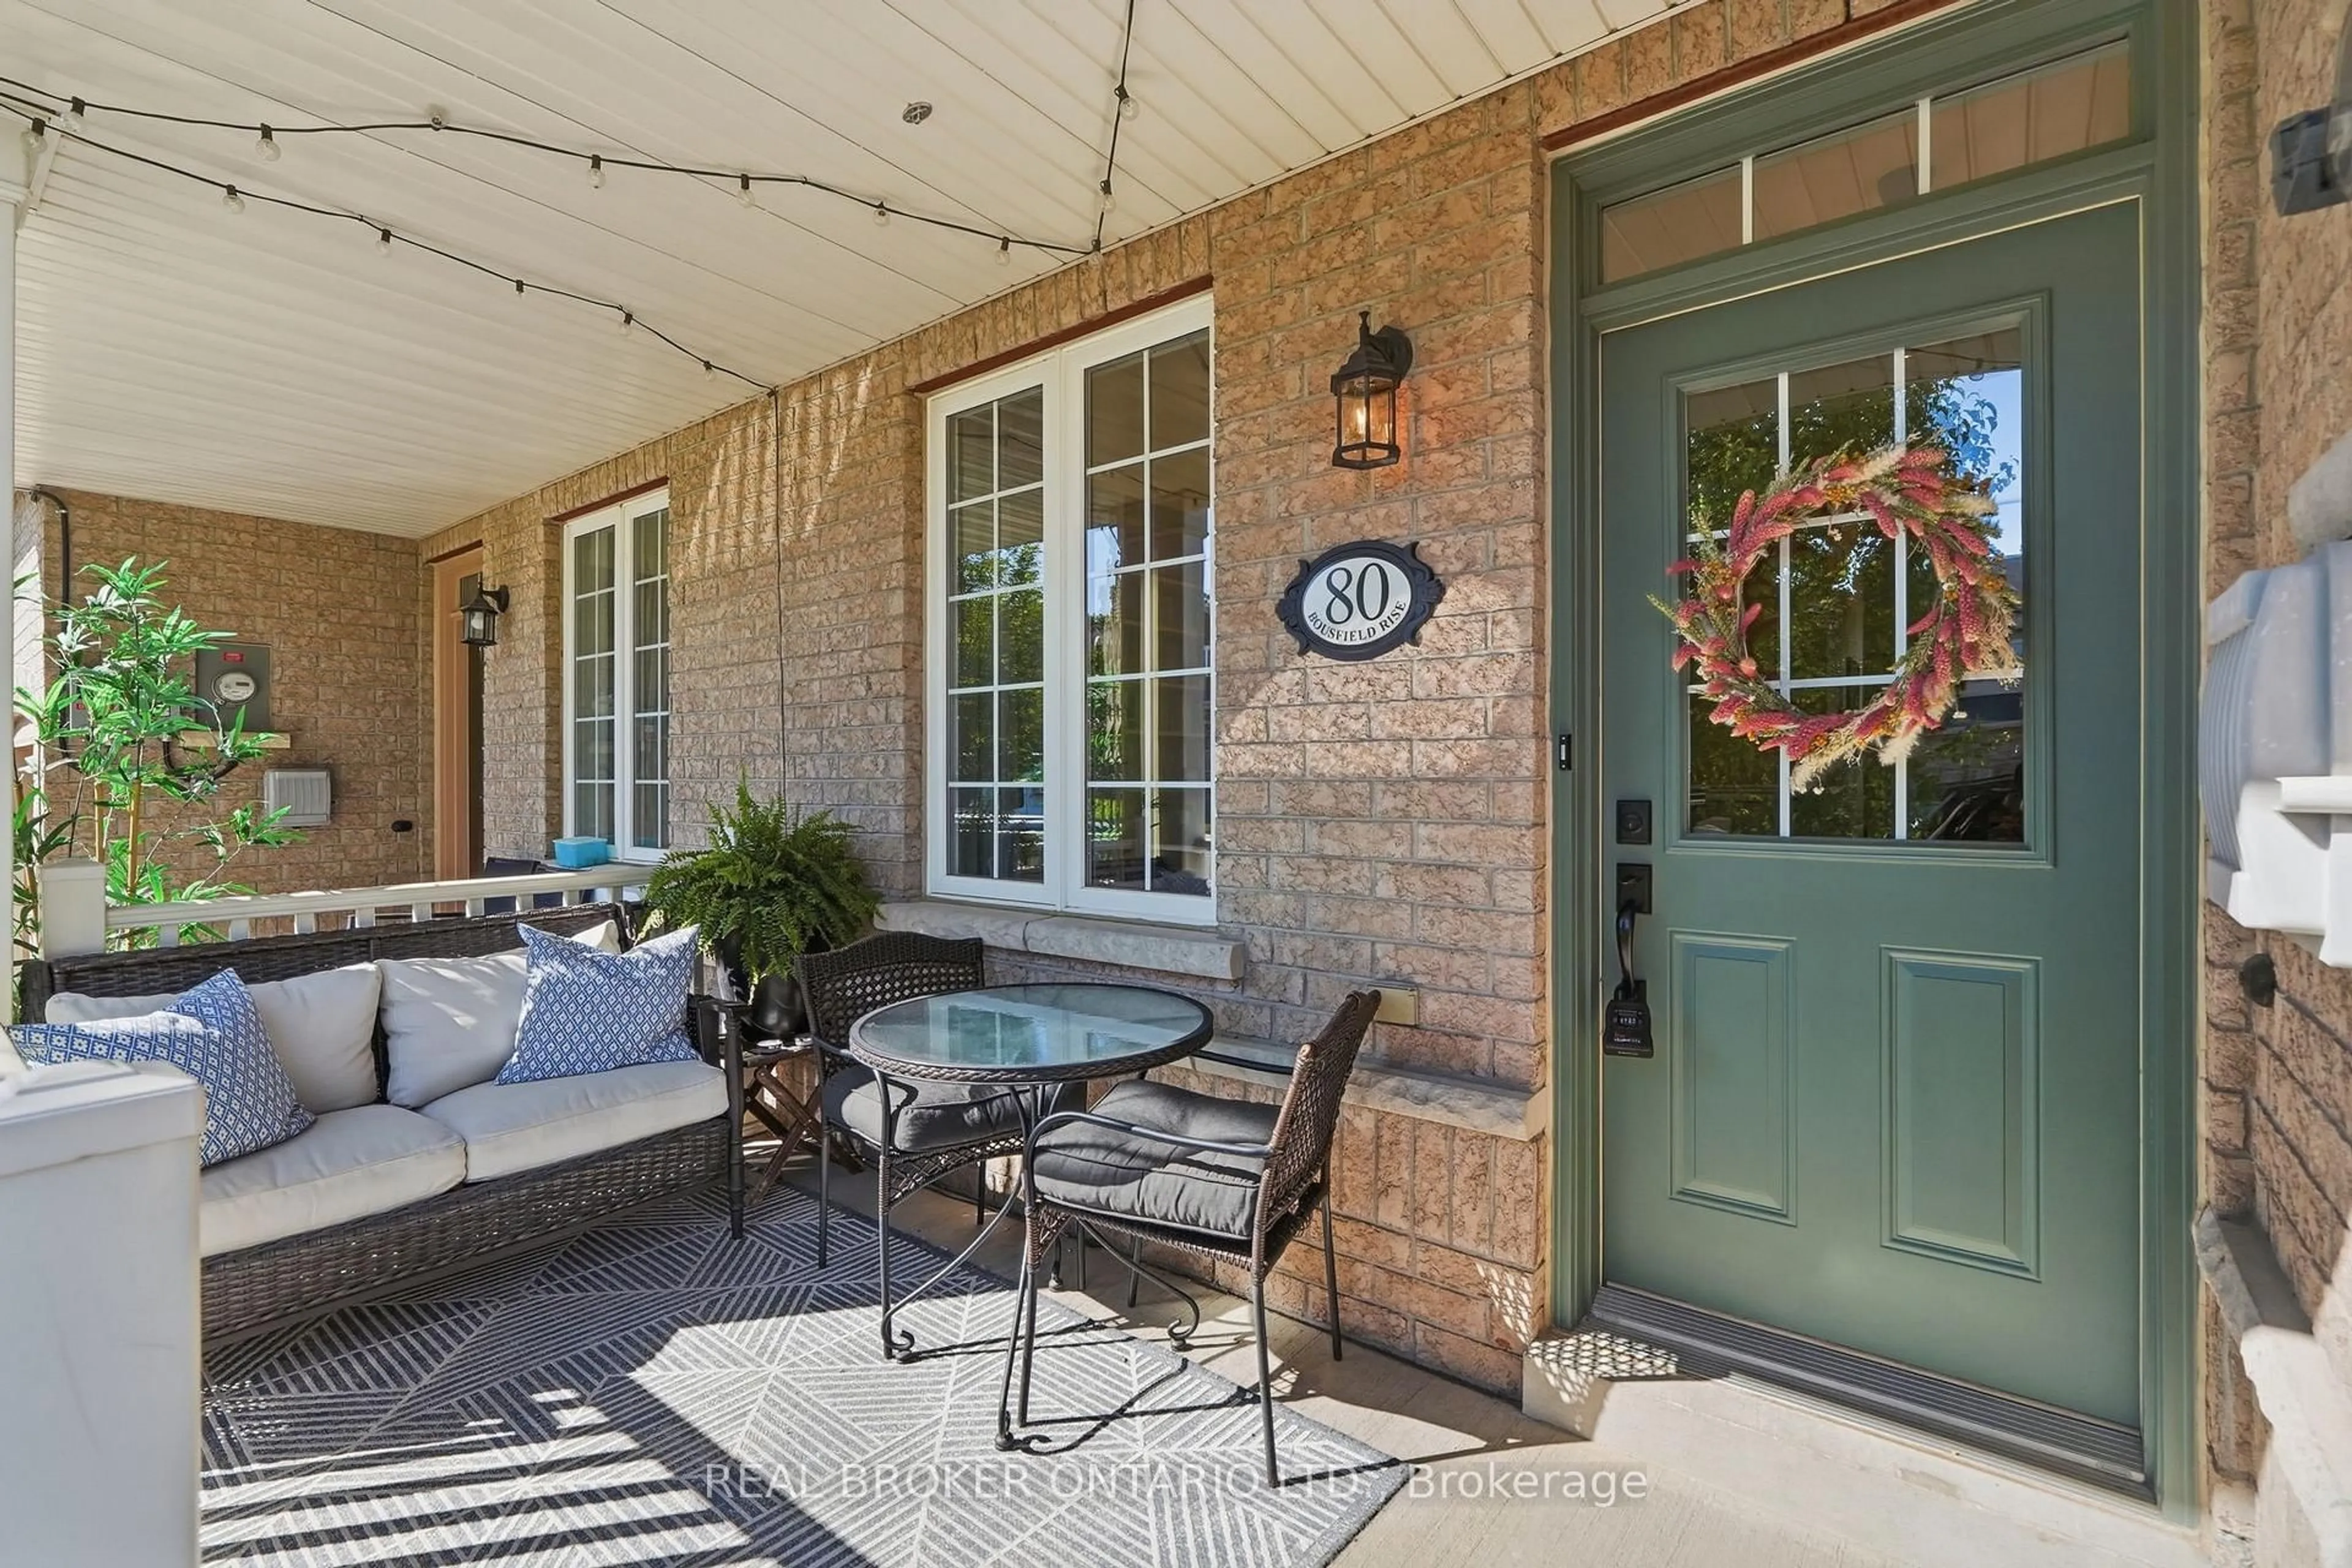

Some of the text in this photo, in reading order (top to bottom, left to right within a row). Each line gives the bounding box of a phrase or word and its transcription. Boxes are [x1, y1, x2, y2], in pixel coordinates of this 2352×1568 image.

[1325, 562, 1389, 624] 80
[1308, 601, 1406, 641] BOUSFIELD RISE
